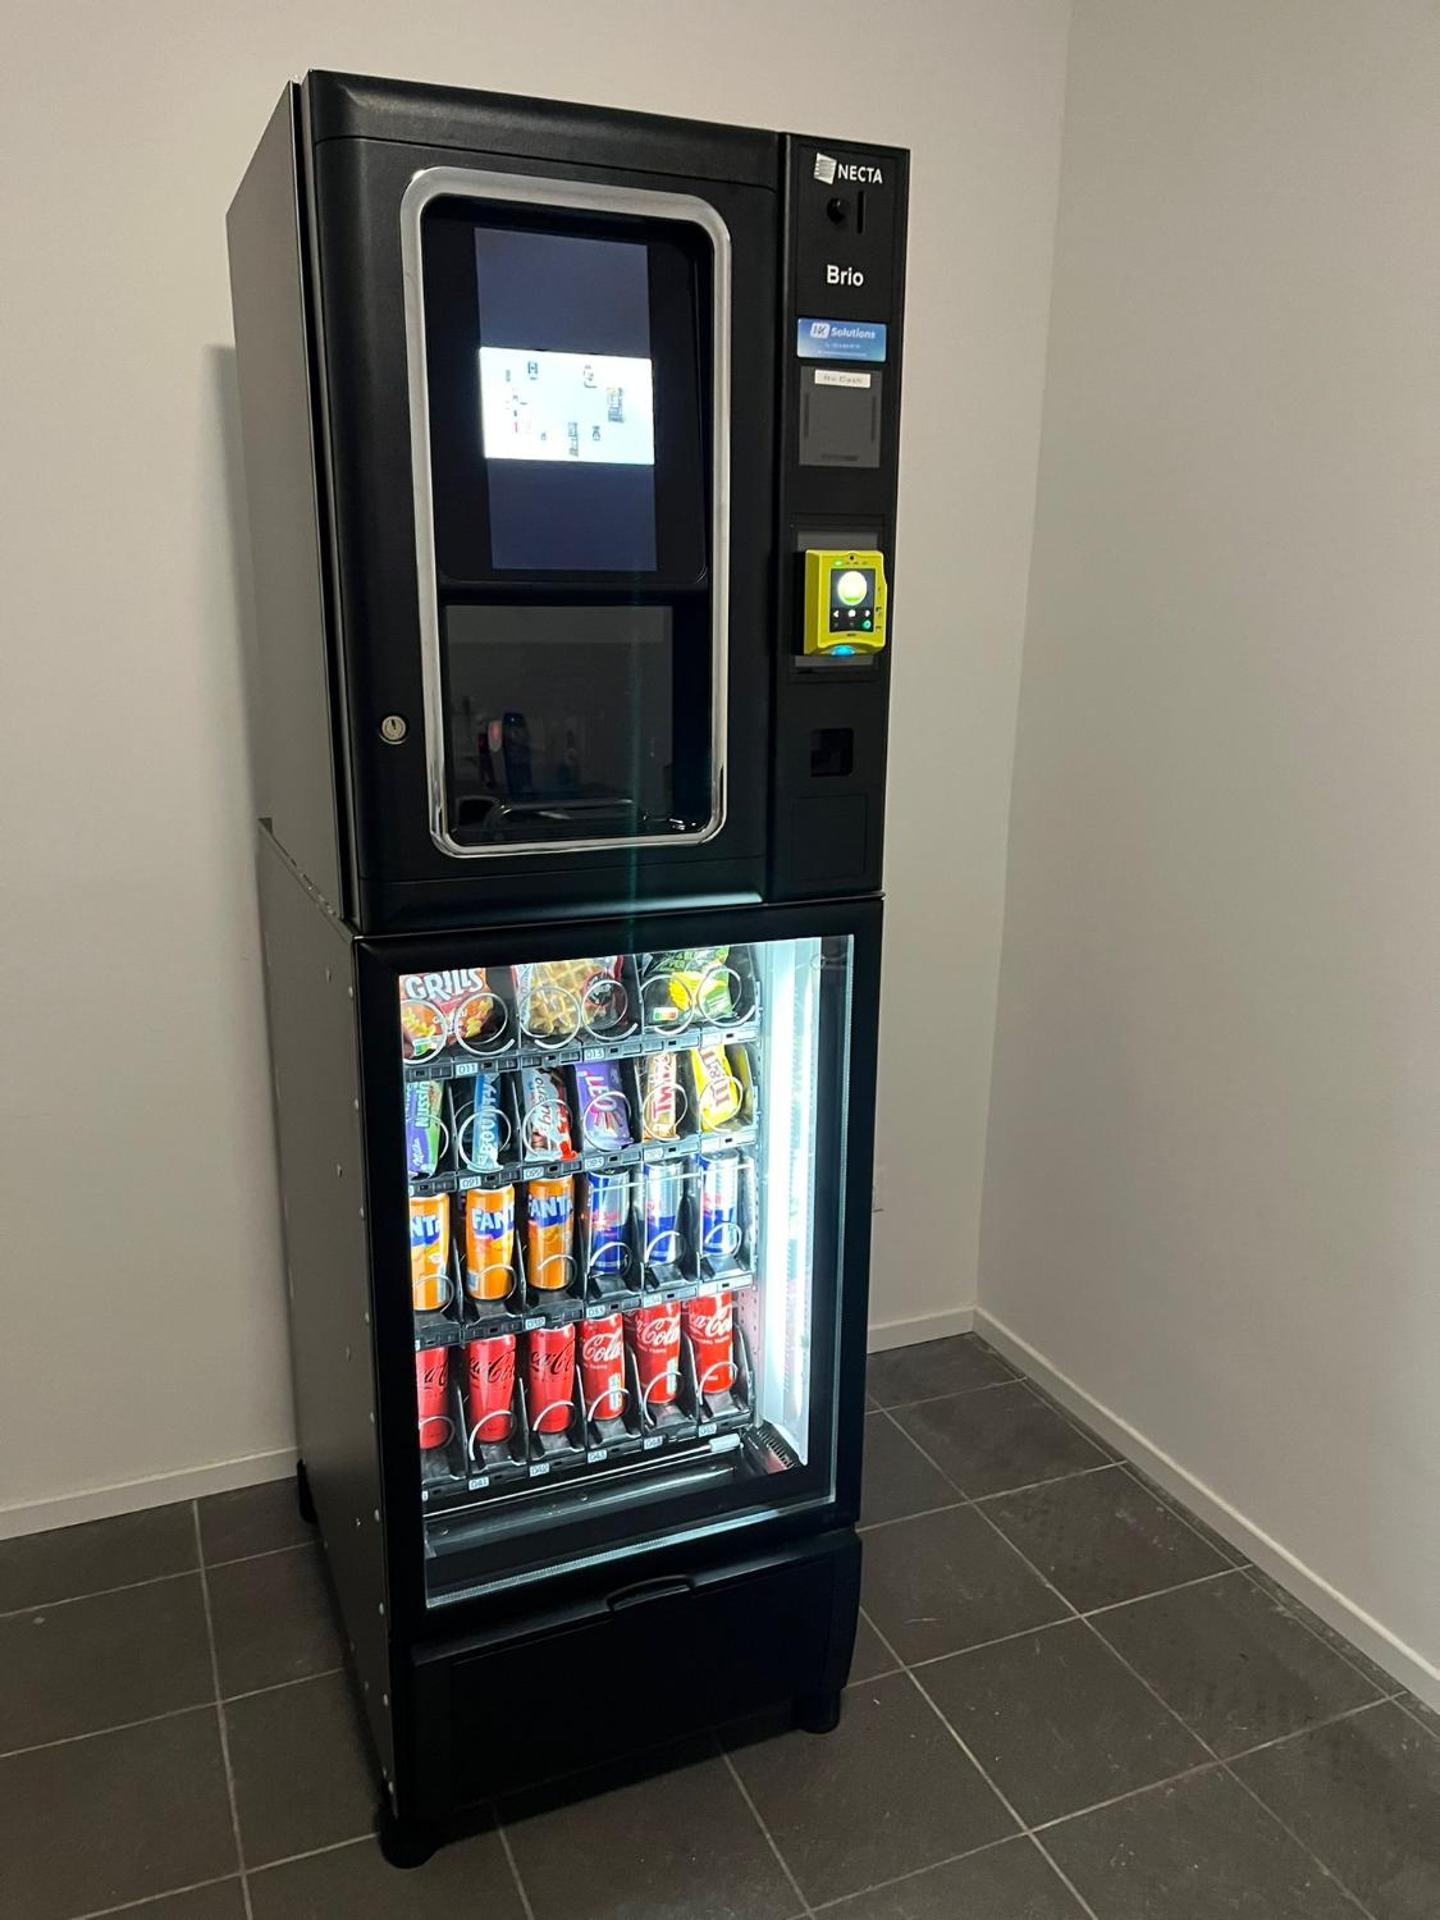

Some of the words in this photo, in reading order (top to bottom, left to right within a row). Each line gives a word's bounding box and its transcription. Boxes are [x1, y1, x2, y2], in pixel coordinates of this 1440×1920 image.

[838, 163, 883, 184] NECTA
[826, 264, 864, 287] Brio
[831, 327, 876, 340] Solutions
[404, 967, 484, 1001] GRILLS
